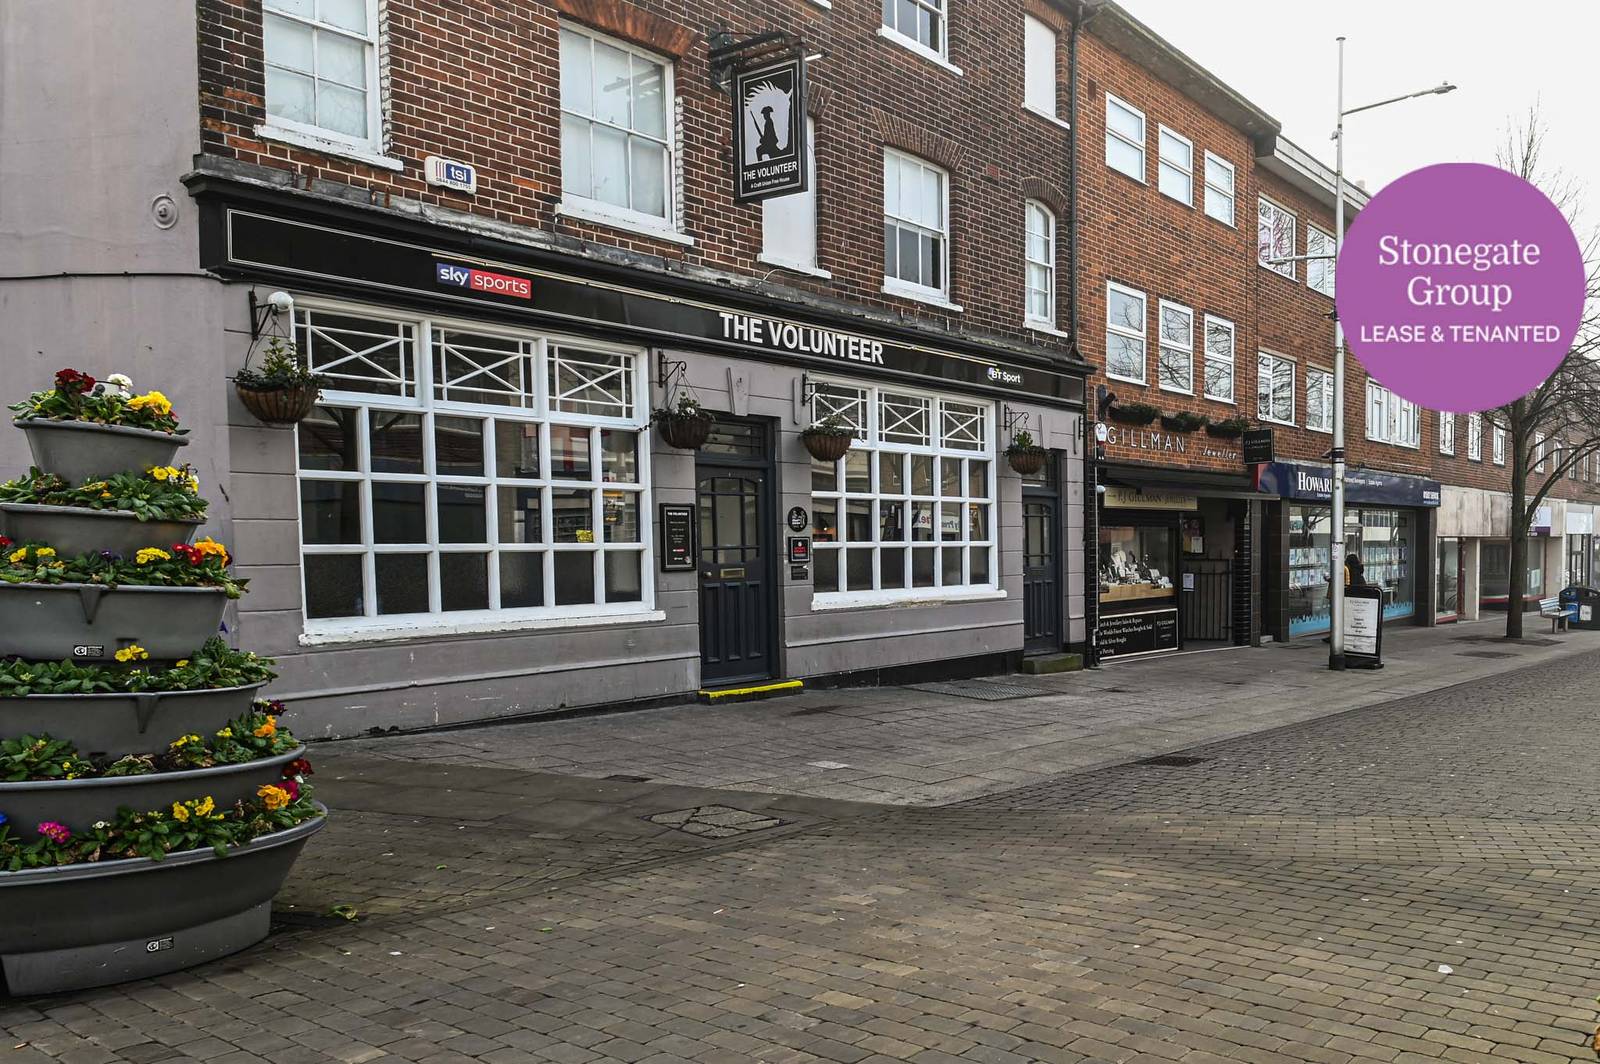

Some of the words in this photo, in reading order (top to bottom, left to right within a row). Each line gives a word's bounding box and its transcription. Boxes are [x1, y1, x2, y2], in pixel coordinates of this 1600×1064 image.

[450, 166, 467, 182] tsi
[743, 170, 756, 181] THE
[757, 161, 798, 178] VOLUNTEER
[440, 266, 469, 286] sky
[474, 274, 529, 294] sports
[719, 312, 763, 344] THE
[768, 321, 884, 365] VOLUNTEER
[1003, 371, 1020, 383] Sport
[1107, 426, 1185, 453] GILLMAN
